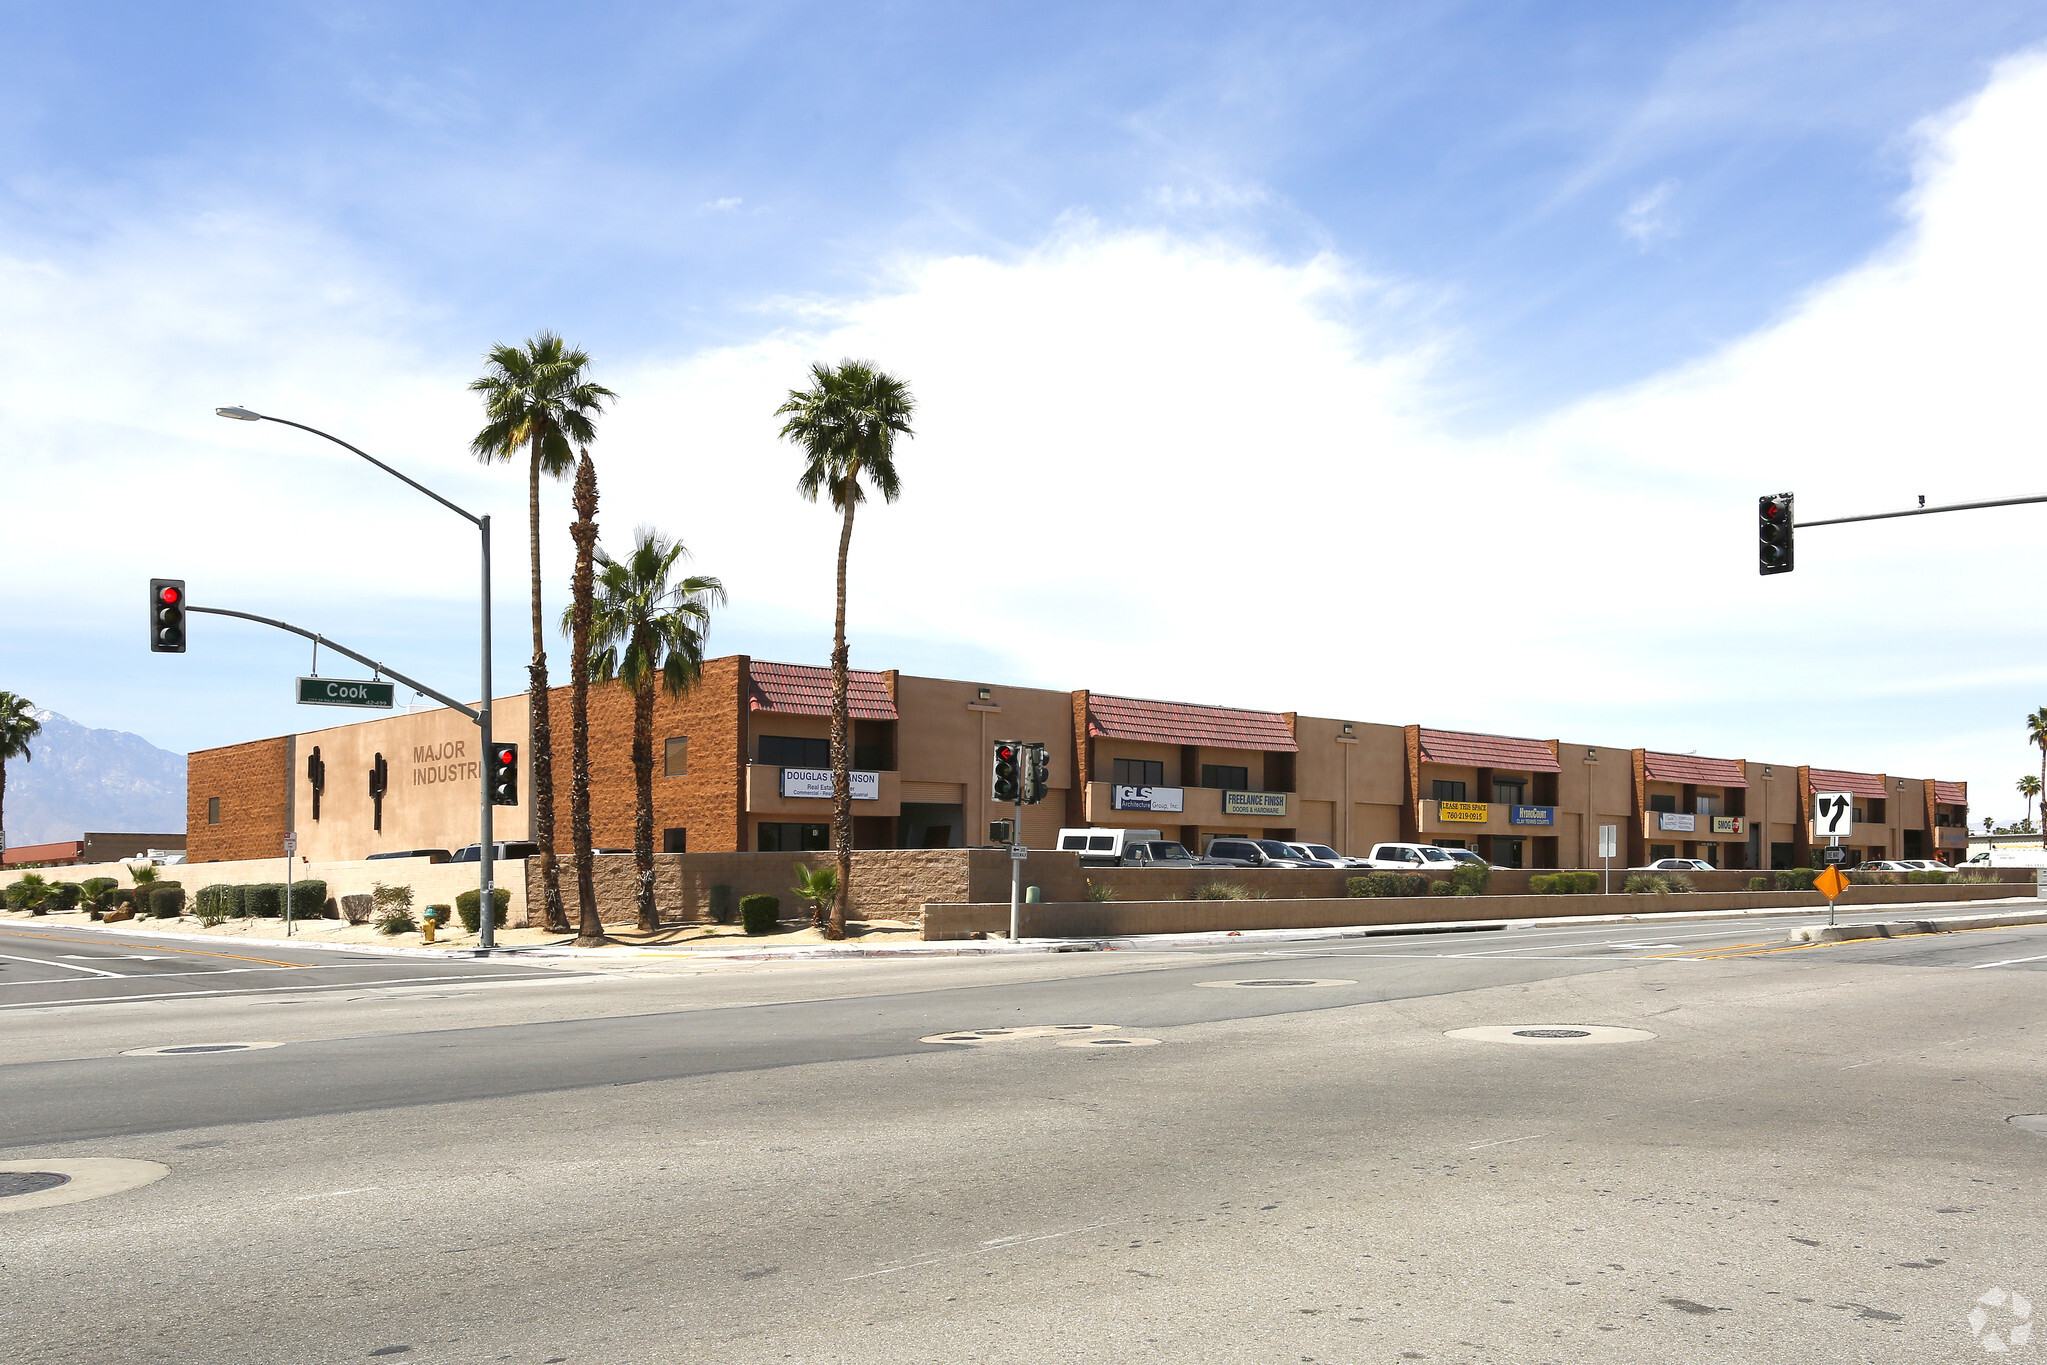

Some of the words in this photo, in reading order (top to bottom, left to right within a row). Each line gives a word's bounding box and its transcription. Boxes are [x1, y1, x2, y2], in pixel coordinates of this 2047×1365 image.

[326, 683, 367, 699] Cook
[413, 740, 465, 763] MAJOR
[413, 761, 481, 786] INDUSTRI
[787, 771, 828, 781] DOUGLAS
[849, 774, 875, 784] NSON
[1121, 786, 1153, 802] GLS
[1228, 793, 1263, 806] FREELANCE
[1264, 795, 1284, 807] FINISH
[1122, 800, 1150, 808] Architecture
[1442, 802, 1459, 810] LEASE
[1460, 803, 1471, 811] THIS
[1472, 804, 1487, 812] SPACE
[1717, 820, 1731, 830] SMOG
